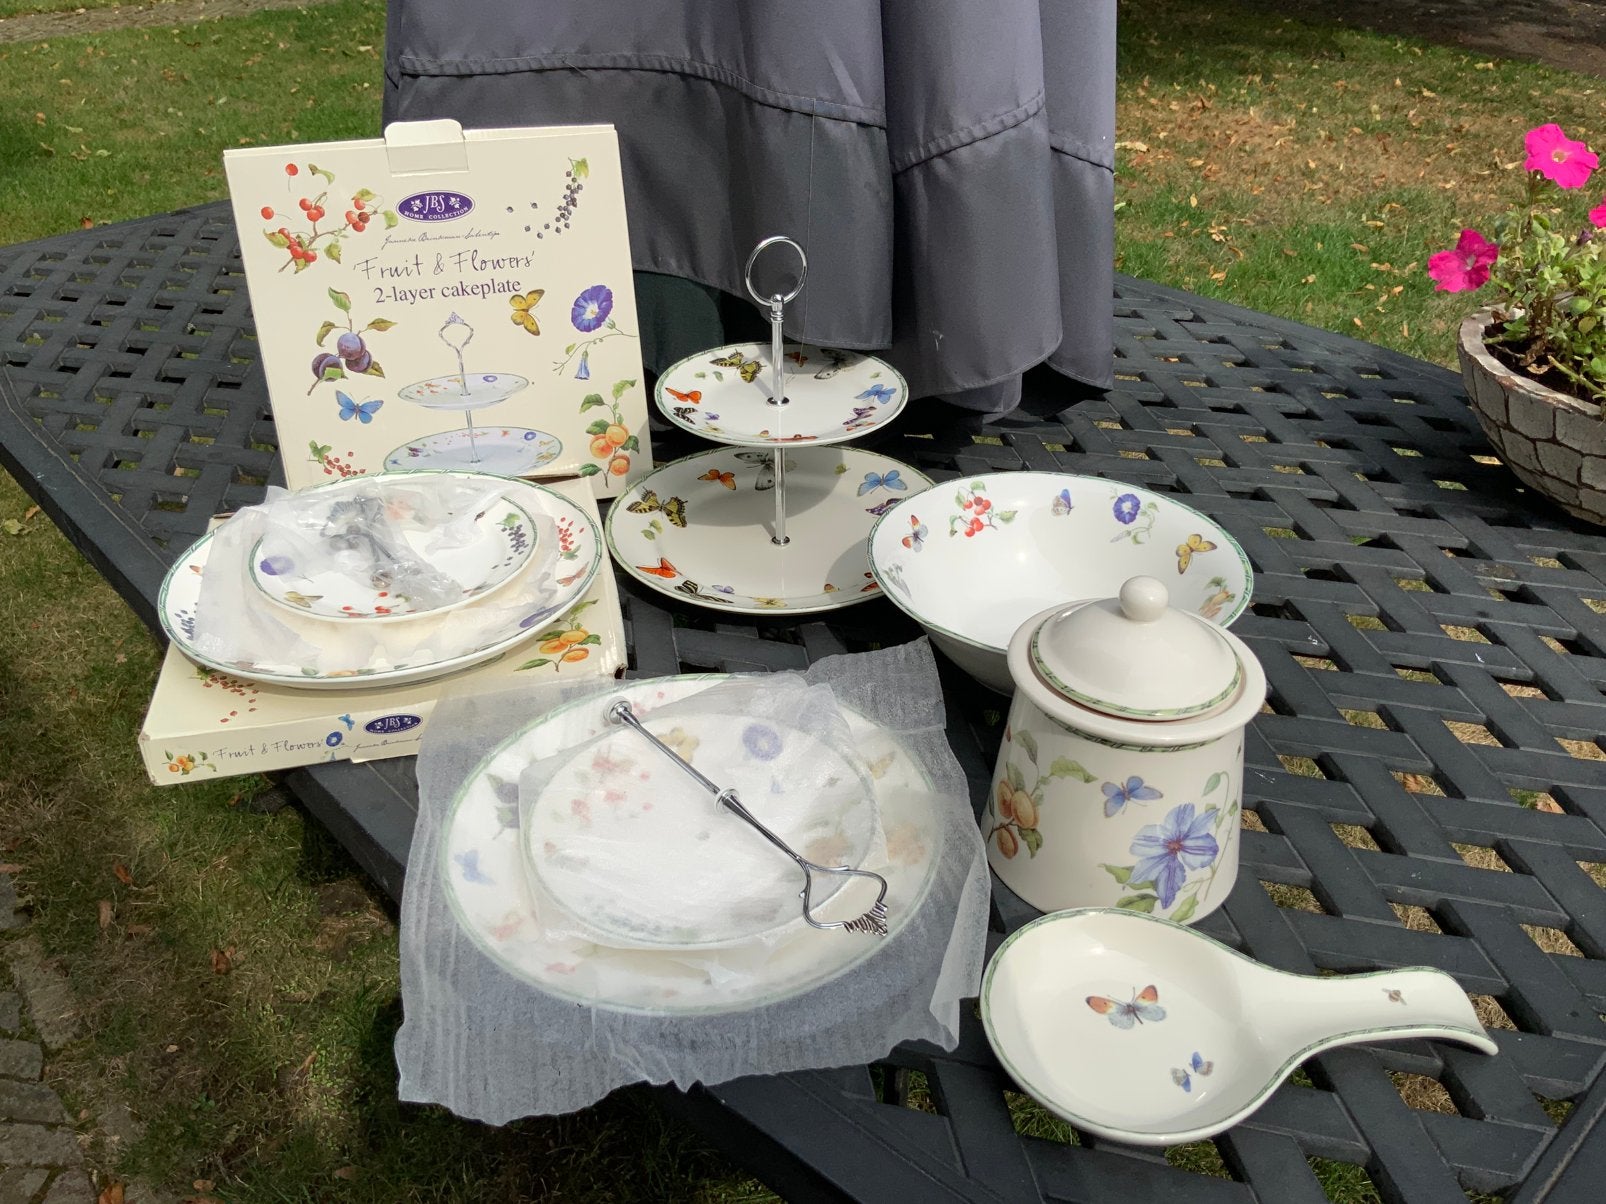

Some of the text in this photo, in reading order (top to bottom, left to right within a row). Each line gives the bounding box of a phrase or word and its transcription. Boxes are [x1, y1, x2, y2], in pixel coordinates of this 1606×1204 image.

[423, 194, 446, 214] JBS
[404, 206, 469, 220] HOME COLLECTION
[433, 252, 445, 276] &
[373, 278, 522, 305] 2-layer cakeplate
[384, 717, 401, 730] JBS
[261, 743, 268, 755] &
